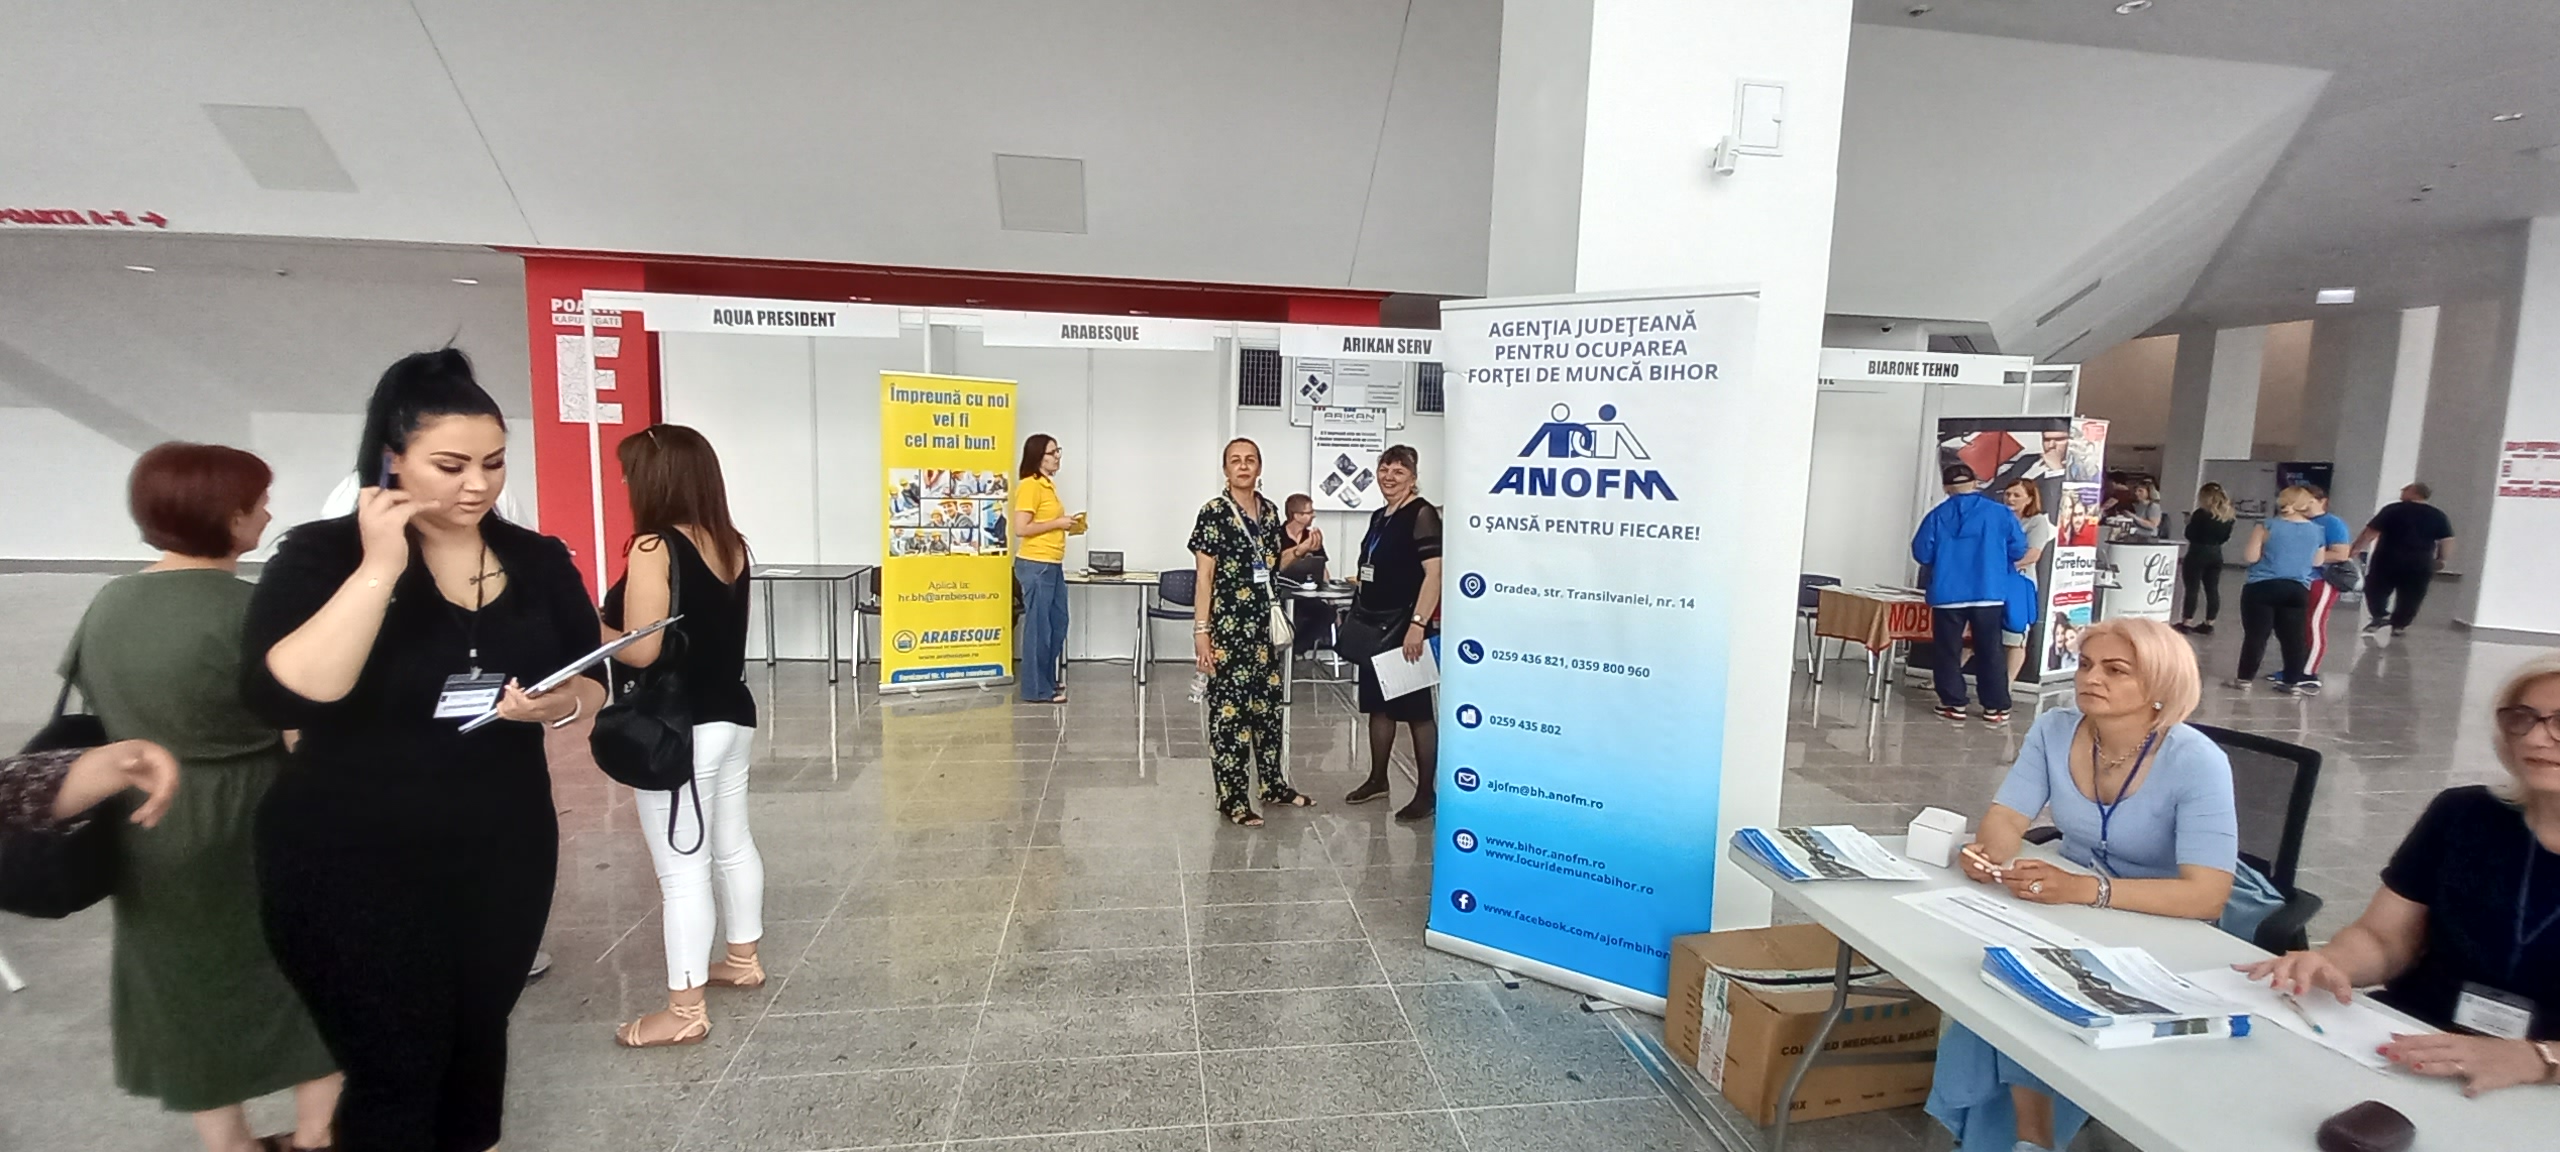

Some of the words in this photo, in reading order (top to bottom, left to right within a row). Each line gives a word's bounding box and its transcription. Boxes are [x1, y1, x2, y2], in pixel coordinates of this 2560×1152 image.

[594, 317, 620, 326] GATE
[713, 308, 755, 327] AQUA
[757, 310, 837, 328] PRESIDENT
[1060, 323, 1140, 342] ARABESQUE
[1342, 336, 1395, 354] ARIKAN
[1397, 338, 1433, 355] SERV
[1495, 342, 1570, 361] PENTRU
[1575, 339, 1688, 359] OCUPAREA
[1535, 366, 1561, 383] DE
[1565, 360, 1643, 382] MUNCĂ
[1649, 363, 1719, 381] BIHOR
[1867, 360, 1920, 376] BIARONE
[1922, 362, 1960, 378] TEHNO
[890, 382, 962, 406] Împreună
[965, 394, 984, 407] cu
[987, 393, 1010, 408] noi
[932, 411, 955, 428] vei
[959, 412, 969, 428] fi
[1323, 412, 1376, 421] ARIKAN
[904, 432, 928, 448] cel
[932, 434, 960, 449] mai
[964, 434, 996, 451] bun!
[1488, 466, 1680, 502] ANOFM
[1468, 514, 1482, 529] O
[1545, 518, 1615, 536] PENTRU
[1619, 521, 1702, 542] FIECARE!
[1493, 582, 1541, 597] Oradea,
[1543, 586, 1564, 599] str.
[1567, 588, 1653, 608] Transilvaniei,
[1656, 597, 1676, 609] nr.
[1679, 597, 1696, 609] 14
[919, 627, 1003, 644] ARABESQUE
[1491, 649, 1519, 662] 0259
[1520, 653, 1542, 665] 436
[1544, 656, 1569, 669] 821,
[1571, 659, 1600, 672] 0359
[1602, 663, 1625, 676] 800
[1627, 666, 1651, 678] 960
[1489, 715, 1516, 729] 0259
[1517, 720, 1539, 733] 435
[1540, 723, 1562, 736] 802
[1487, 779, 1604, 810] ajofm@bh.anofm.ro
[1485, 835, 1606, 870] www.bihor.anofm.ro
[1484, 848, 1655, 896] www.locuridemuncabihor.ro
[1483, 902, 1670, 960] www.facebook.com/ajofmbihor
[1842, 1032, 1895, 1050] MEDICAL
[1897, 1027, 1936, 1043] MASKS
